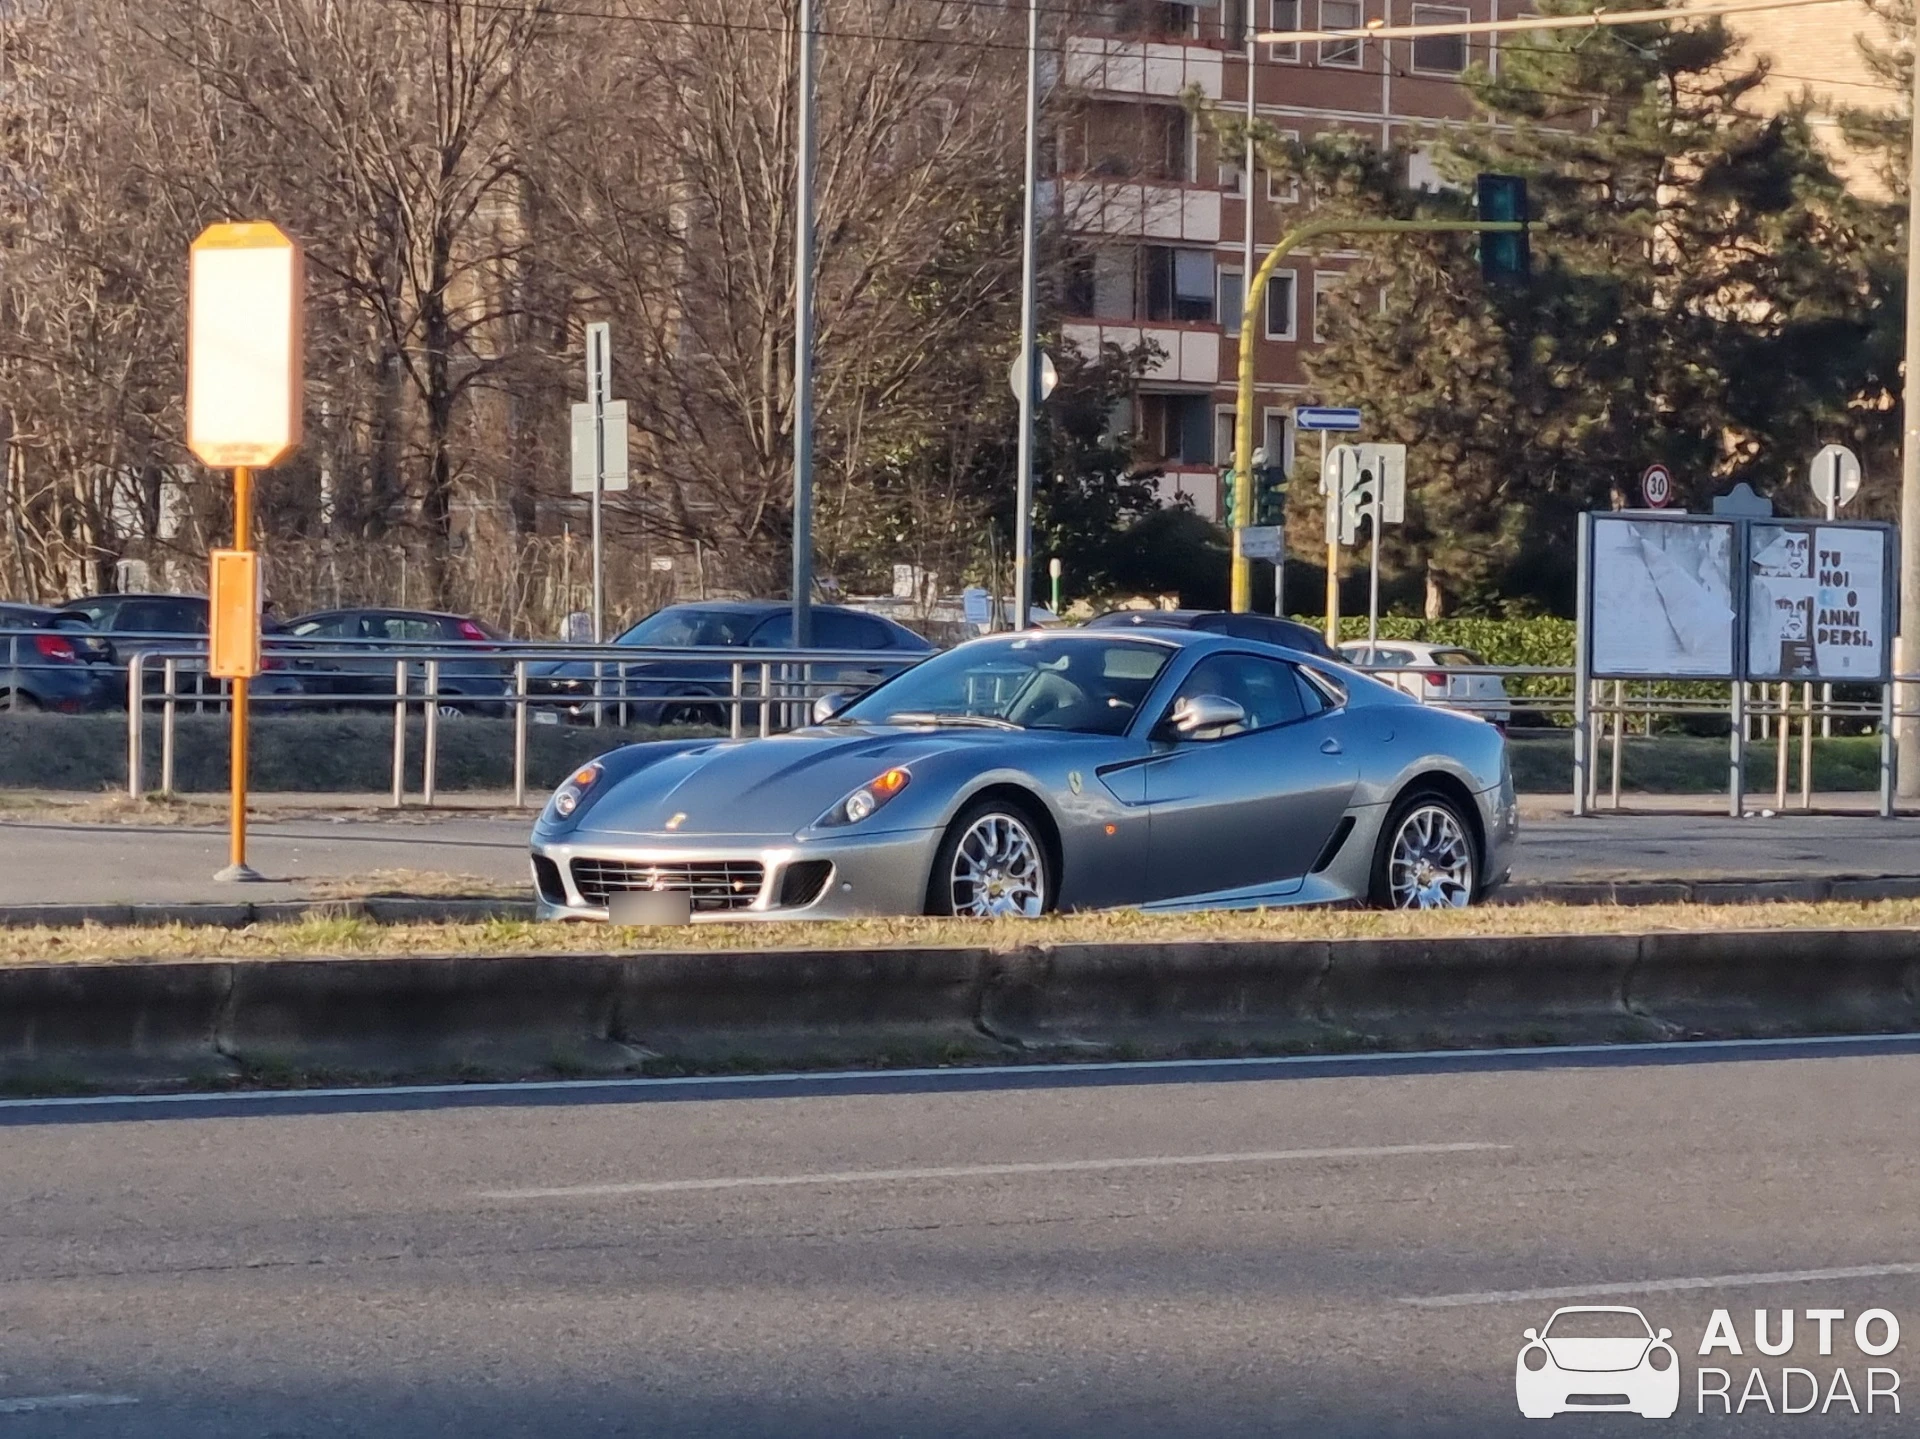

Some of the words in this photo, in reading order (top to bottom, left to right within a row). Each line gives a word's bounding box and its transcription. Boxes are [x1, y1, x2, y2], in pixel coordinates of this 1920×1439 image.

[1650, 476, 1665, 496] 30
[1819, 550, 1841, 568] TU
[1818, 569, 1849, 588] NOI
